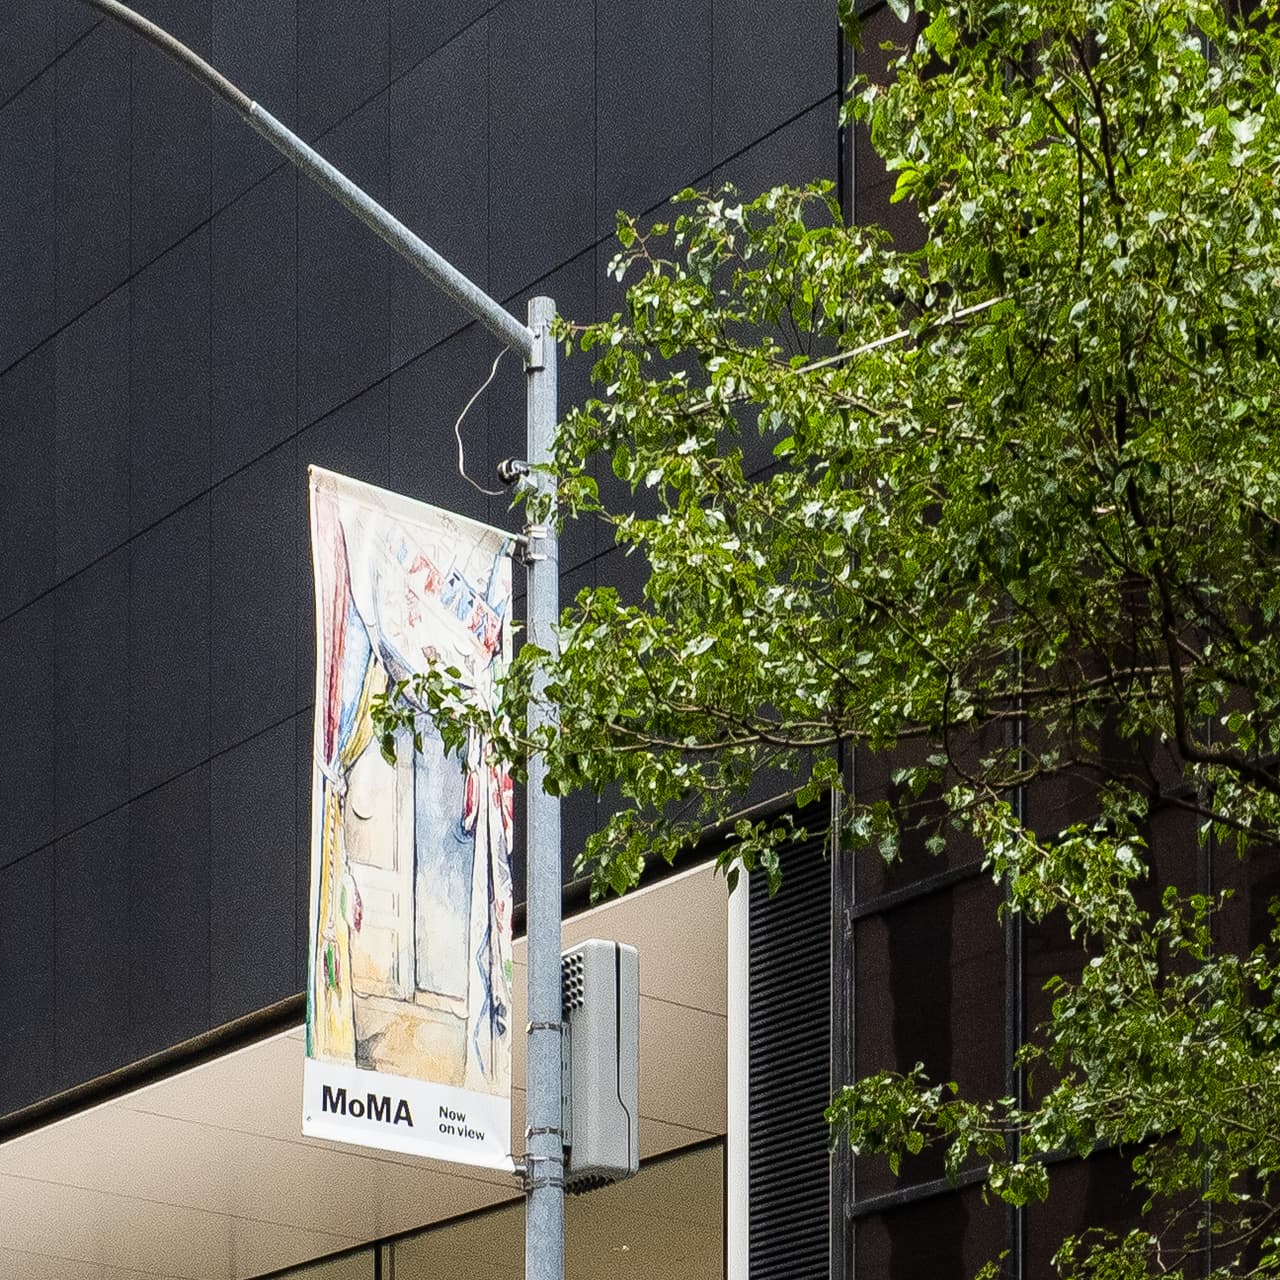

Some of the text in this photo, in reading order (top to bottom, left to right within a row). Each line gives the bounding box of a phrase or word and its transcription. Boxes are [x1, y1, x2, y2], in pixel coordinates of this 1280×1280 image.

[321, 1084, 414, 1128] MoMA
[439, 1105, 466, 1123] Now
[439, 1122, 485, 1141] on view
